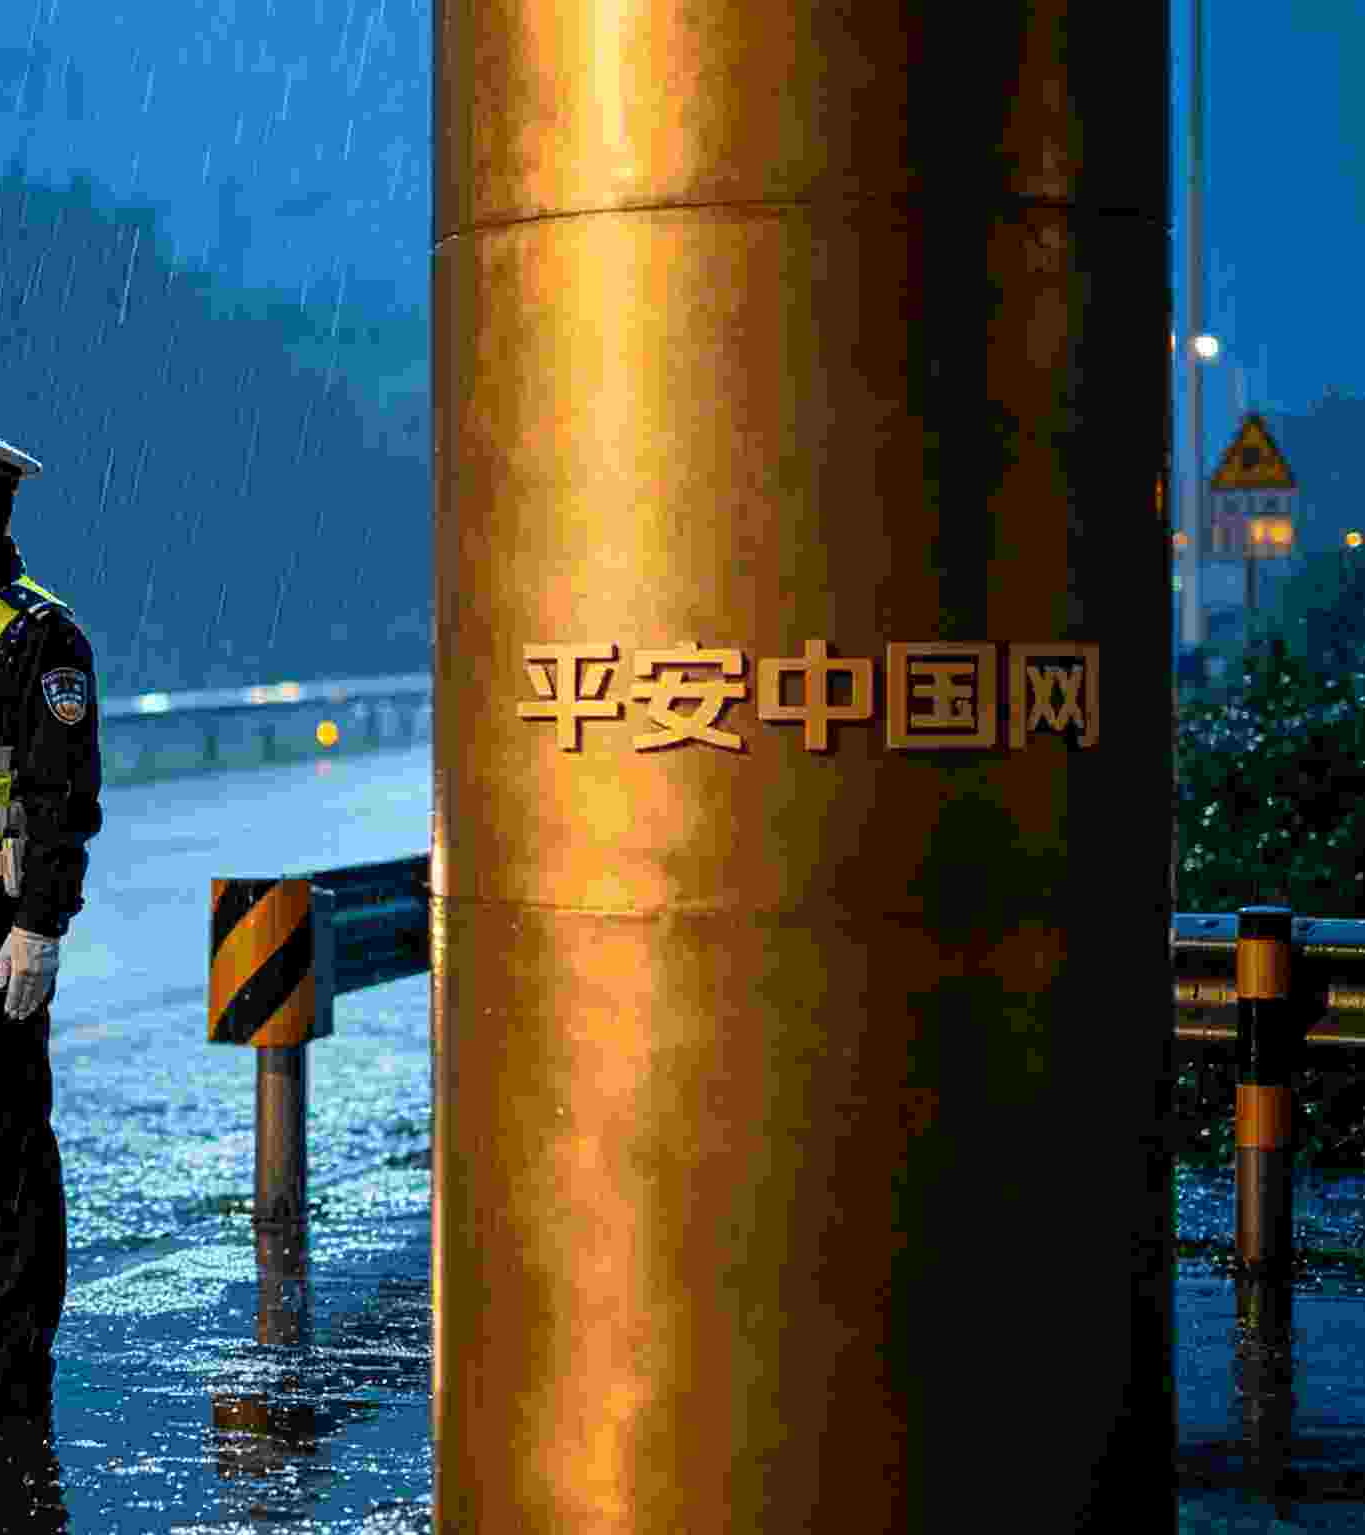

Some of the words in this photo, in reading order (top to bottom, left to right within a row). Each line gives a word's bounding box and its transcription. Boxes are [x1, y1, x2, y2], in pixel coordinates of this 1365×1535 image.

[516, 640, 1099, 751] 平安中国网
